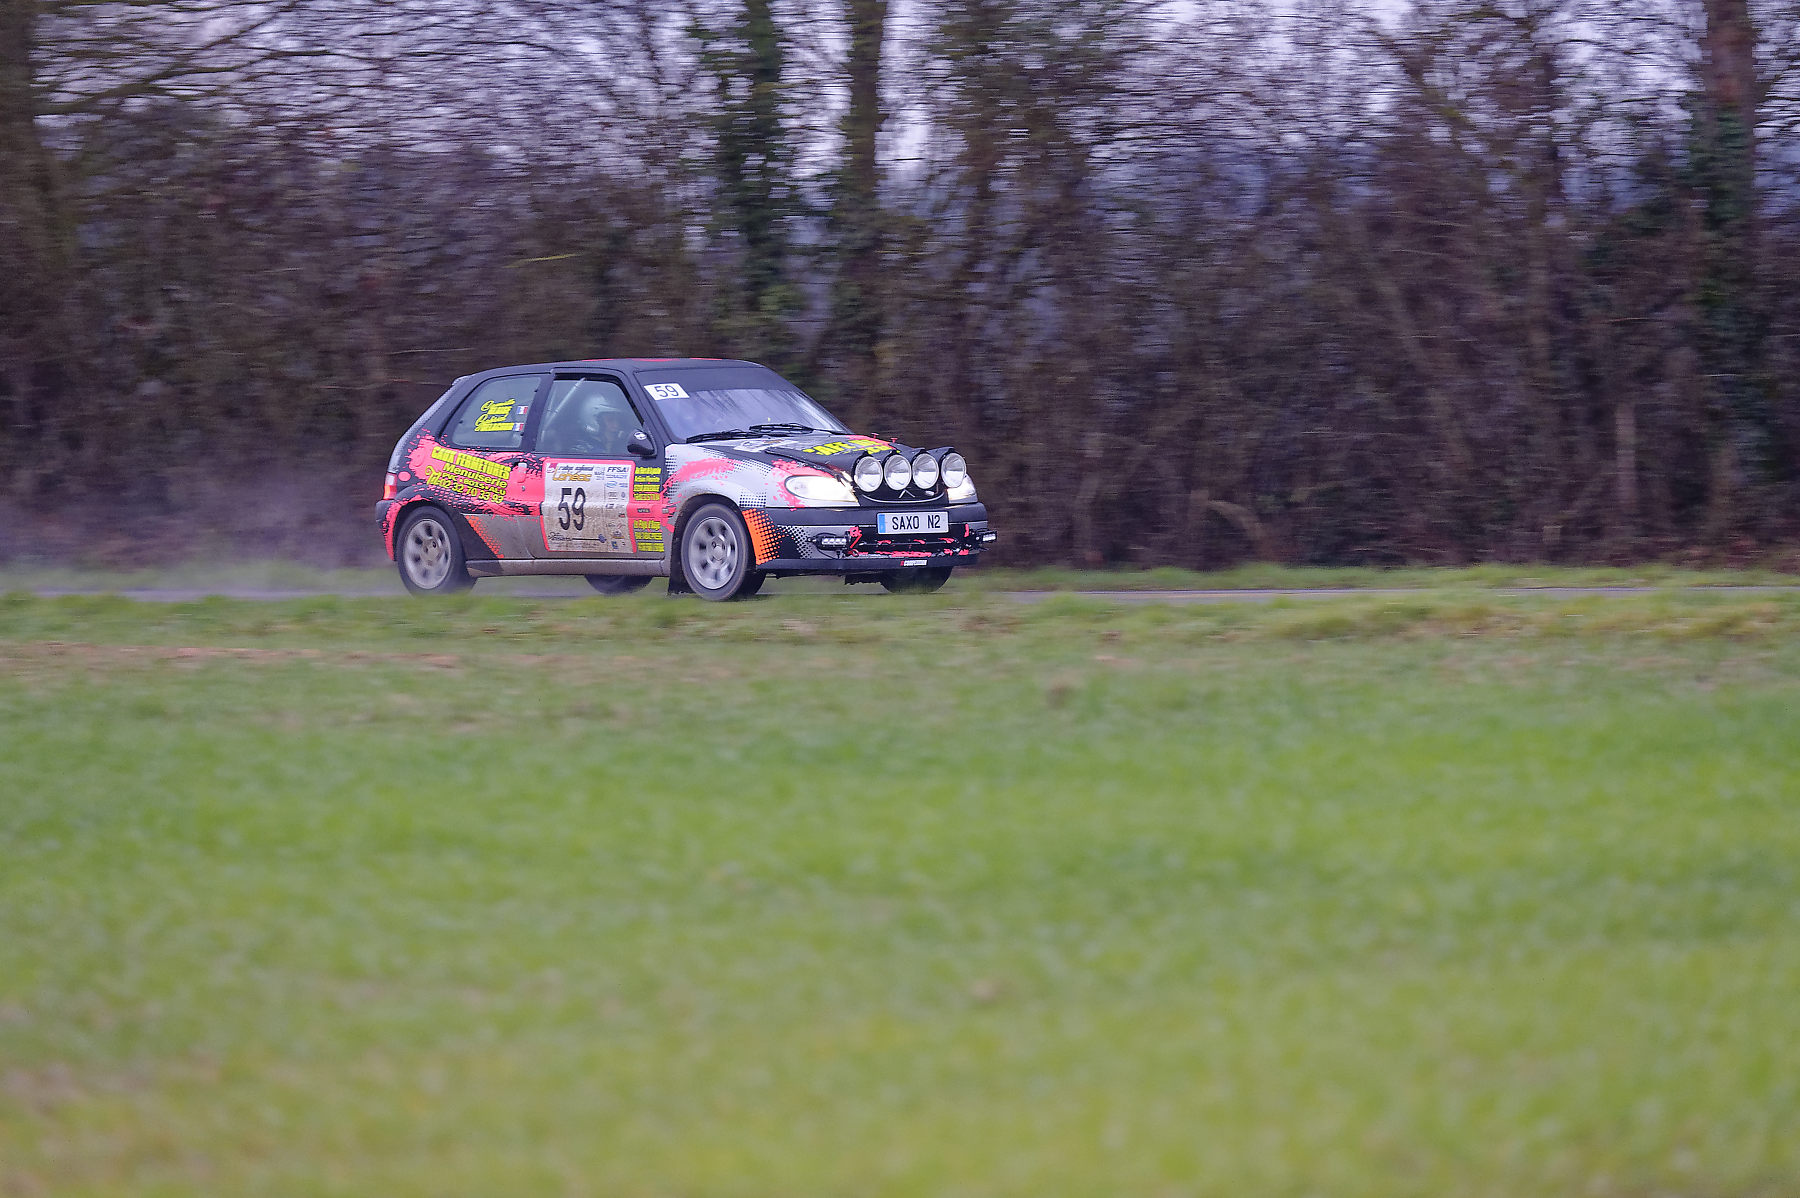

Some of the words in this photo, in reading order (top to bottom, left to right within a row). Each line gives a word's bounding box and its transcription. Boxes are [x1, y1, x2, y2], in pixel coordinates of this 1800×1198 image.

[654, 384, 680, 398] 59
[443, 463, 508, 489] Menuiserie
[439, 478, 452, 489] 02
[451, 482, 465, 494] 32
[465, 486, 478, 497] 70
[478, 490, 491, 501] 33
[558, 487, 586, 531] 59
[892, 515, 920, 530] SAXO
[927, 514, 941, 529] N2
